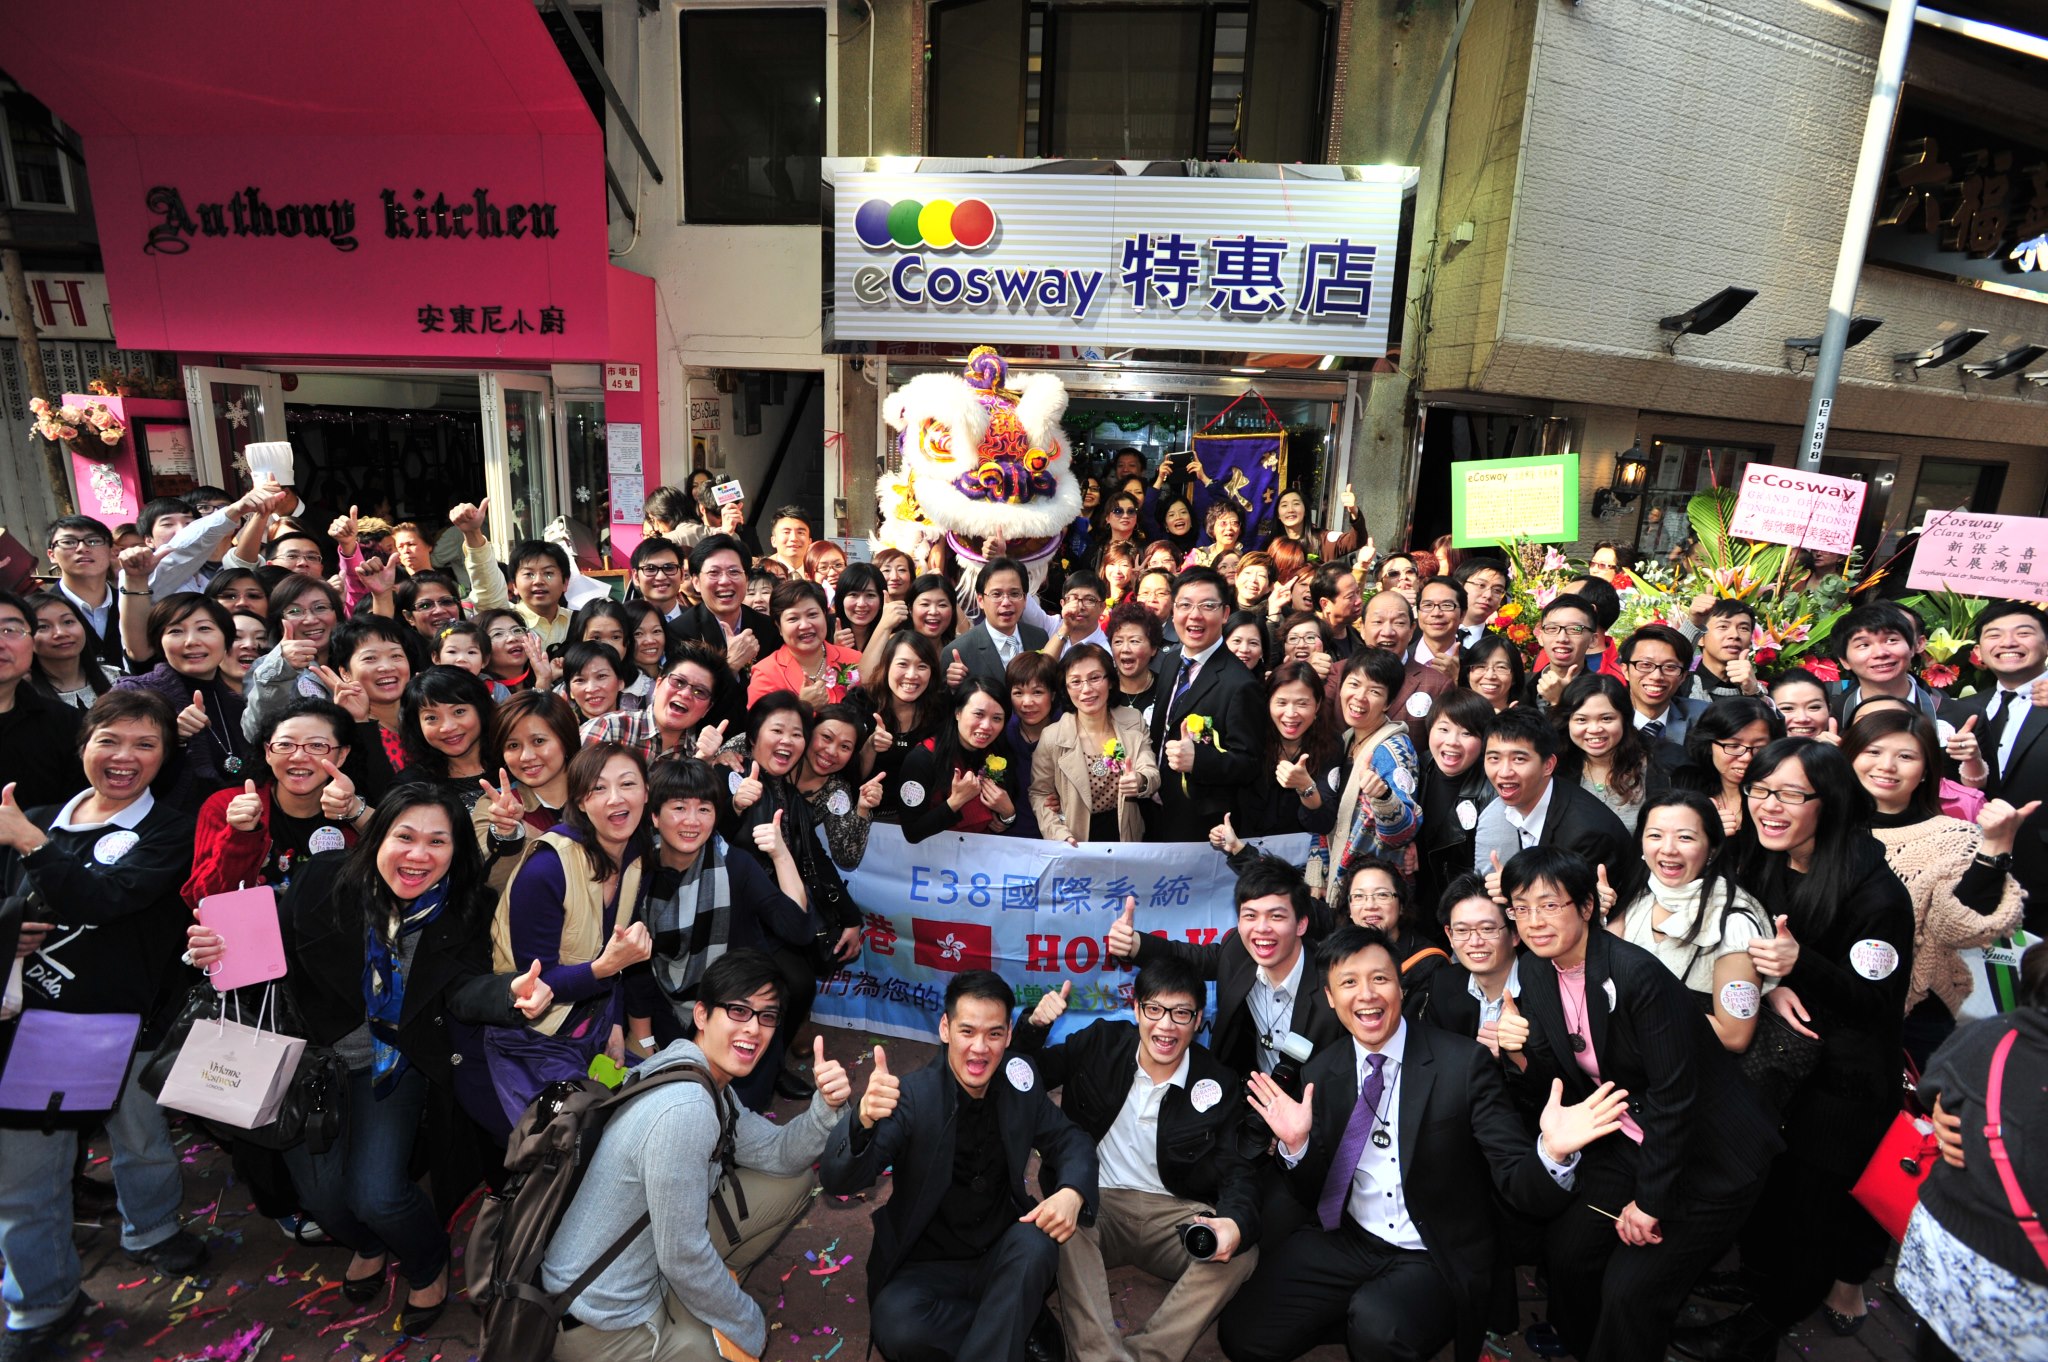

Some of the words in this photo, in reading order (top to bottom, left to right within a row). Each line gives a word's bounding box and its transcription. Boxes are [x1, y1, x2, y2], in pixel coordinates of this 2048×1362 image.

[143, 185, 358, 255] Anthony
[379, 187, 560, 240] kitchen
[852, 253, 1105, 319] eCosway
[1119, 231, 1381, 319] 特惠店
[417, 304, 566, 336] 安東尼小廚
[607, 367, 638, 377] 市場街
[1818, 399, 1831, 417] BE
[1810, 422, 1826, 460] 3898
[1467, 472, 1508, 483] eCosway
[1747, 490, 1790, 504] GRAND
[1748, 474, 1856, 501] eCosway
[1930, 514, 2003, 533] eCosway
[1932, 528, 1964, 538] Clara
[1968, 531, 1992, 540] Koo
[1947, 541, 2037, 560] 新張之喜
[1944, 555, 2032, 575] 大展鴻圖
[1982, 946, 2017, 964] Gucci
